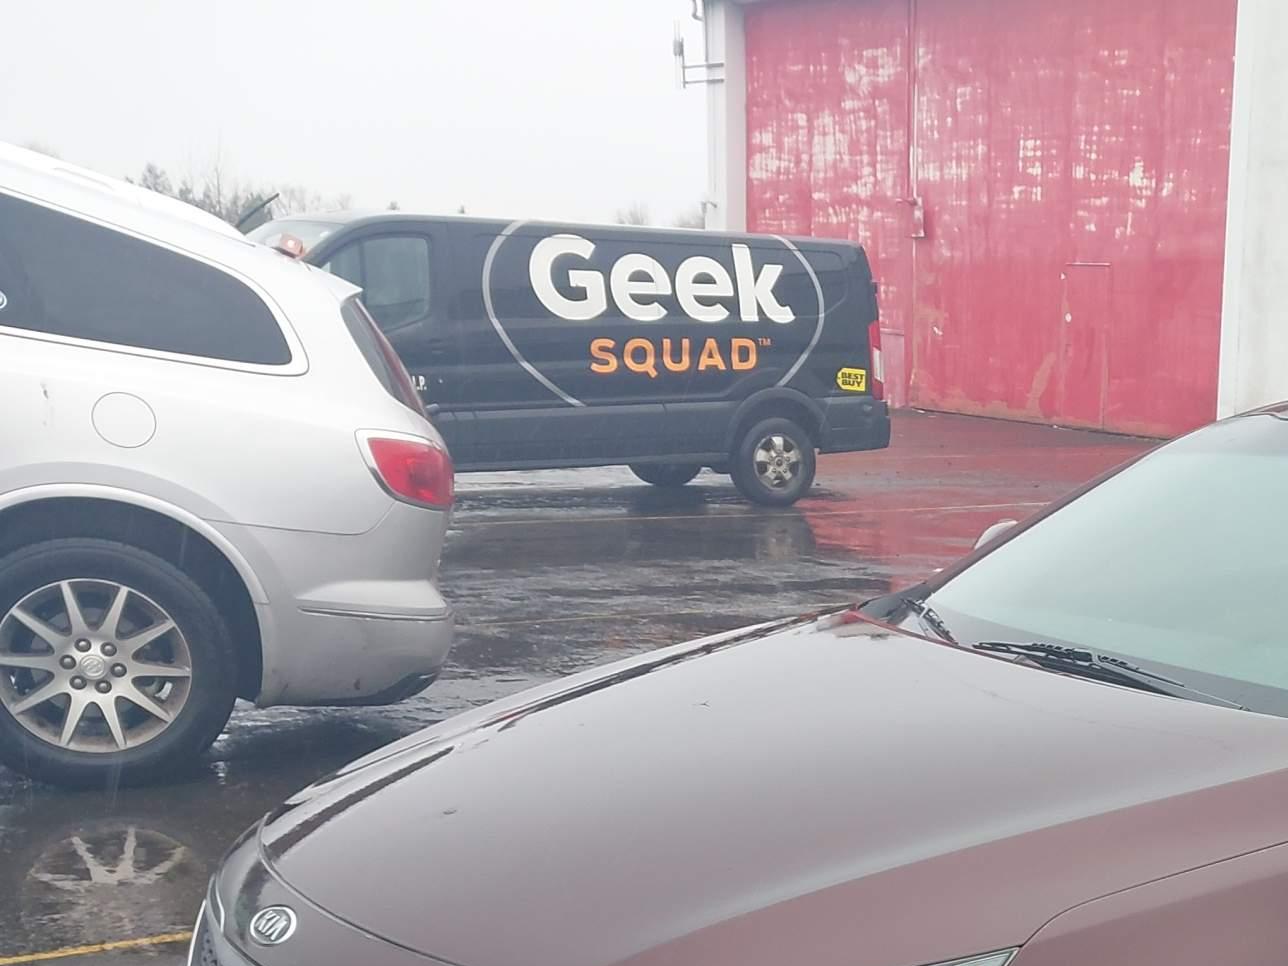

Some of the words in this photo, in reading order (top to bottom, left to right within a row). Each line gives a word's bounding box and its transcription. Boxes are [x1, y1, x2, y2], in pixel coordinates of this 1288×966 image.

[528, 233, 796, 324] Geek
[841, 371, 865, 380] BEST
[841, 379, 862, 387] BUY
[254, 909, 288, 941] KIA
